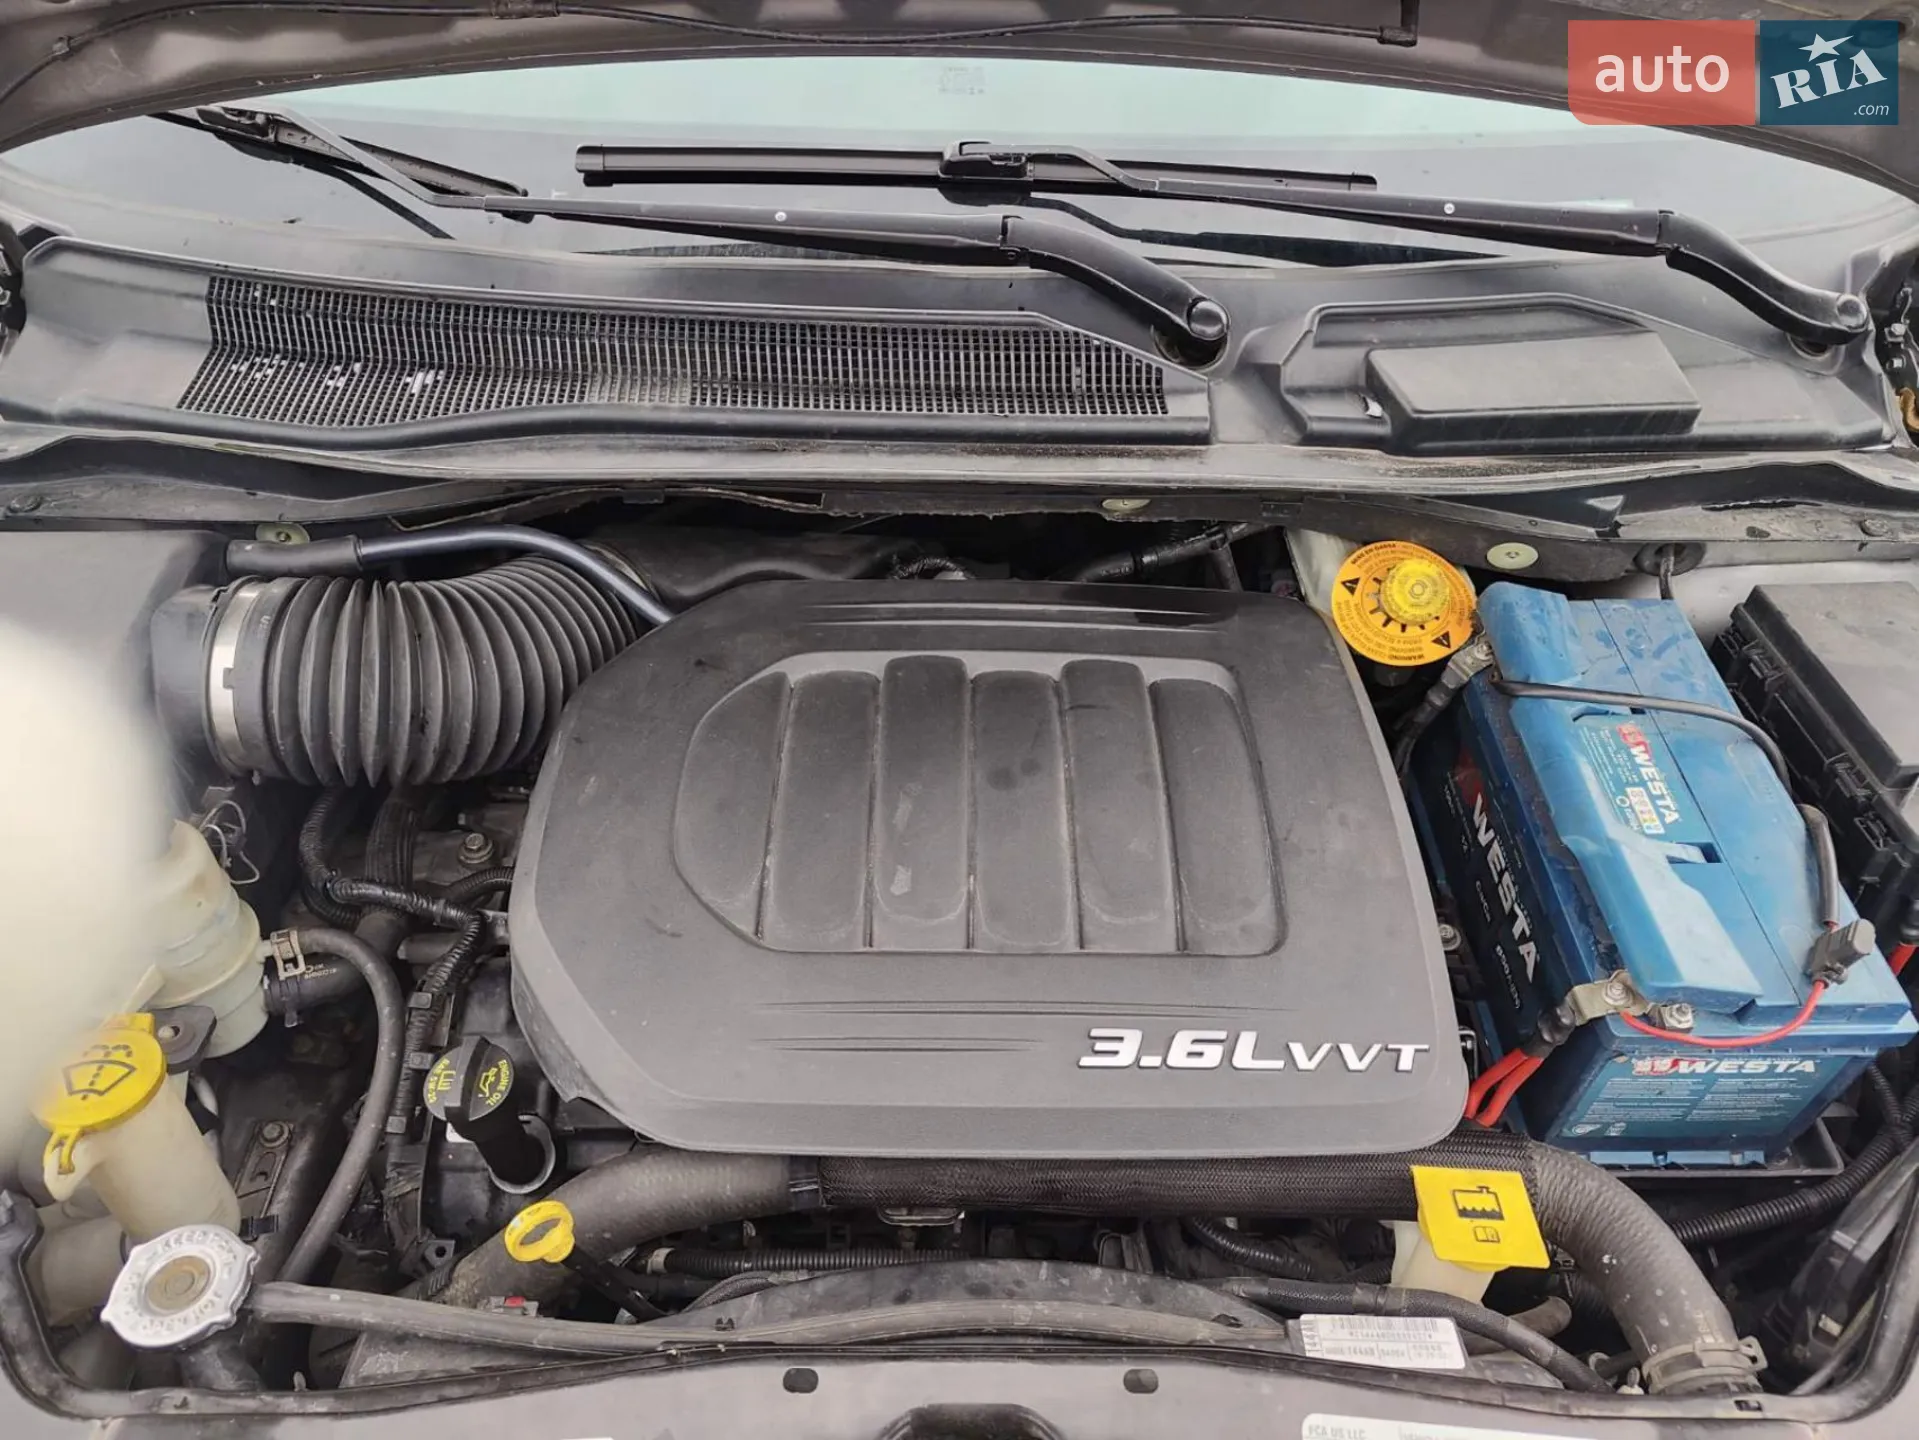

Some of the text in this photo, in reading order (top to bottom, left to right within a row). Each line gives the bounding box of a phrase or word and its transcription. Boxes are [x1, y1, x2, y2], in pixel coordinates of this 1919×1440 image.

[1629, 743, 1680, 825] WESTA
[1473, 791, 1538, 984] WESTA
[498, 1059, 510, 1092] ENGINE
[1674, 1058, 1816, 1074] WESTA
[485, 1092, 502, 1106] OIL
